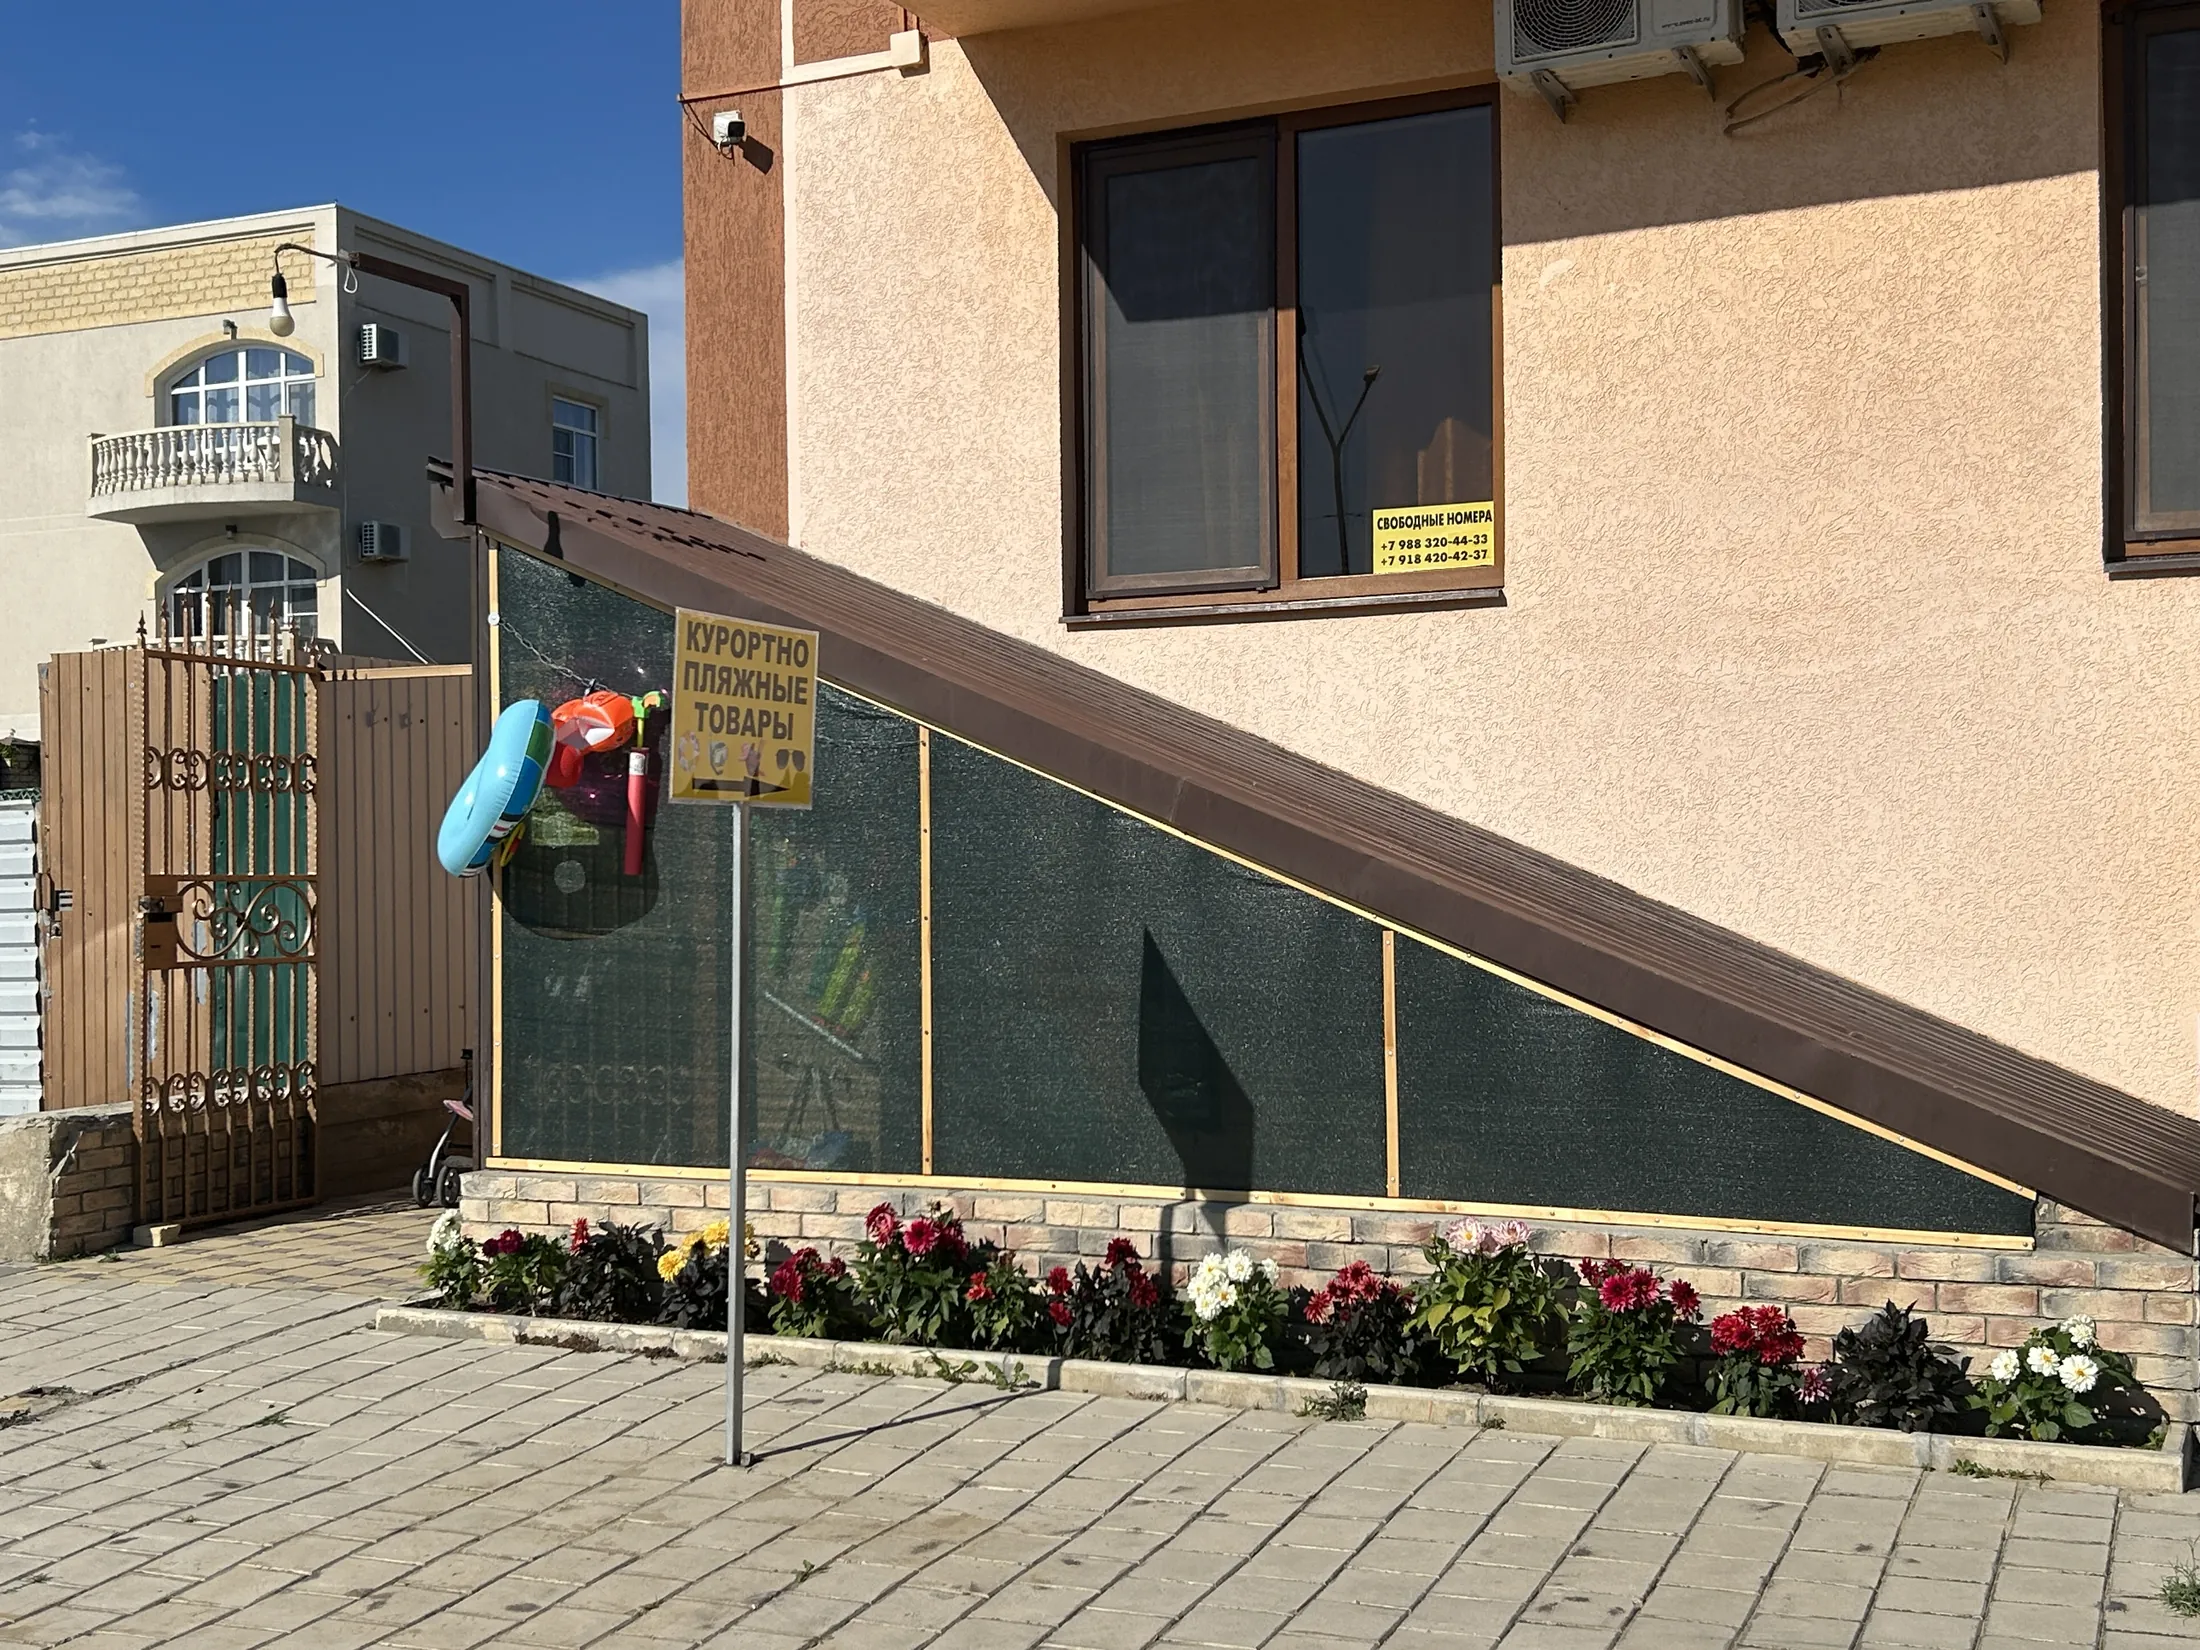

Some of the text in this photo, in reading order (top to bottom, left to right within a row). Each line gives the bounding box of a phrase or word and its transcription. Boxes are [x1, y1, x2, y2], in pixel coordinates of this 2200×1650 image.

[1377, 509, 1493, 530] СВОБОДНЫЕ НОМЕРА
[1381, 534, 1488, 551] +7 988 320-44-33
[1381, 549, 1488, 566] +7 918 420-42-37
[686, 621, 809, 668] КУРОРТНО
[683, 661, 808, 705] ПЛЯЖНЫЕ
[694, 702, 794, 741] ТОВАРЫ
